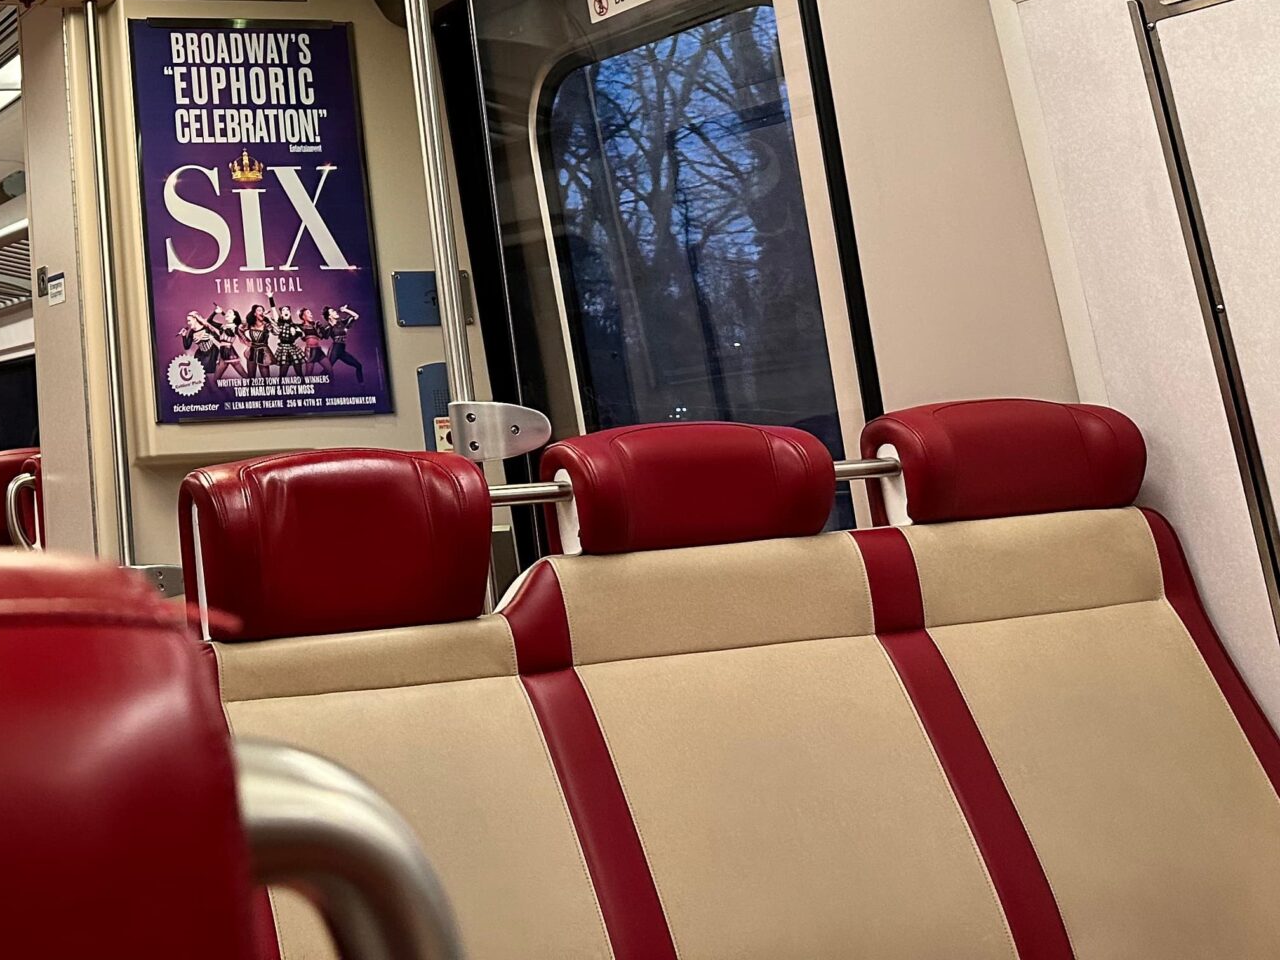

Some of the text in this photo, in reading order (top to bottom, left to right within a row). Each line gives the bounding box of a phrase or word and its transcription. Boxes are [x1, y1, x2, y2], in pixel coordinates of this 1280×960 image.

[170, 32, 312, 65] BROADWAY'S
[163, 66, 315, 105] “EUPHORIC
[174, 108, 328, 144] CELEBRATION!”
[163, 164, 357, 275] SIX
[215, 276, 303, 294] THE MUSICAL
[216, 375, 330, 387] WRITTEN BY 2022 TONY AWARD WINNERS
[234, 384, 315, 397] TOBY MARLOW & LUCY MOSS
[173, 402, 220, 413] ticketmaster
[232, 401, 245, 410] LENA
